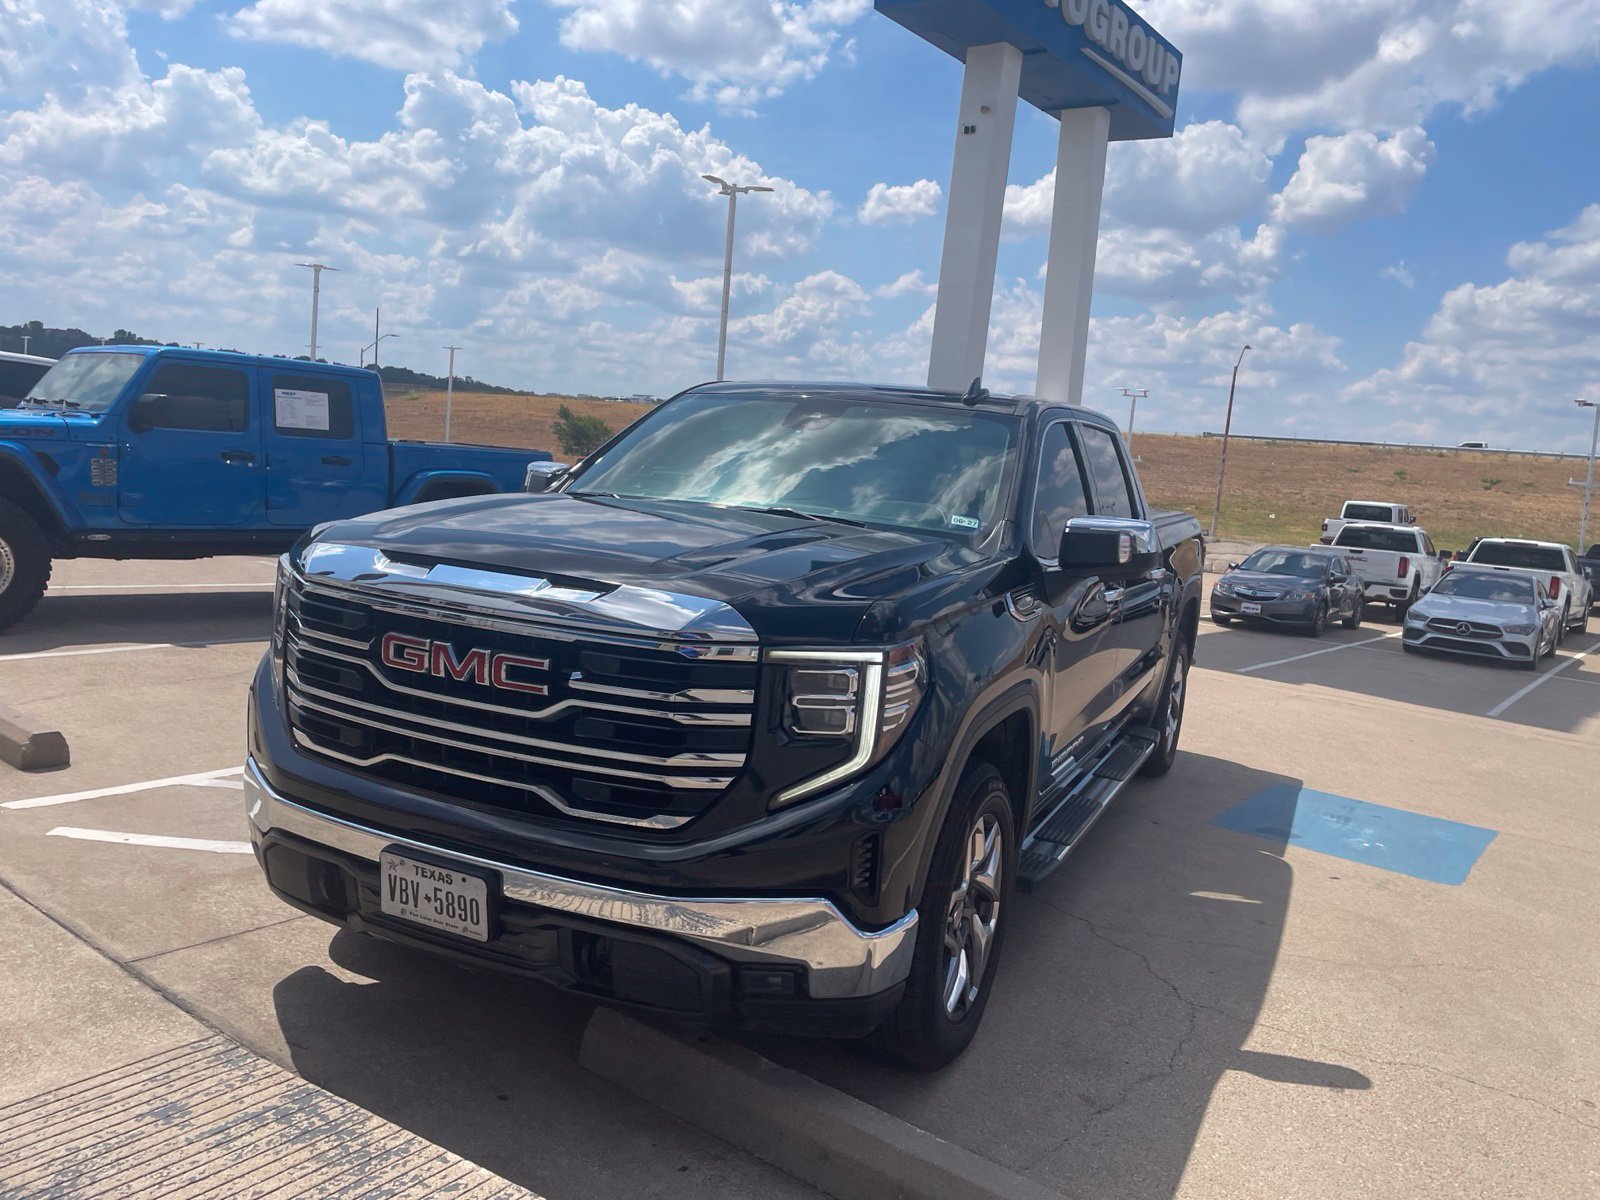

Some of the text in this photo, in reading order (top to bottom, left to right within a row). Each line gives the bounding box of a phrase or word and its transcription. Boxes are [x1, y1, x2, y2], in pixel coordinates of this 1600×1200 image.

[1043, 0, 1180, 95] OGROUP
[381, 632, 550, 696] GMC
[388, 874, 480, 926] VBV 5890
[412, 865, 453, 885] TEXAS
